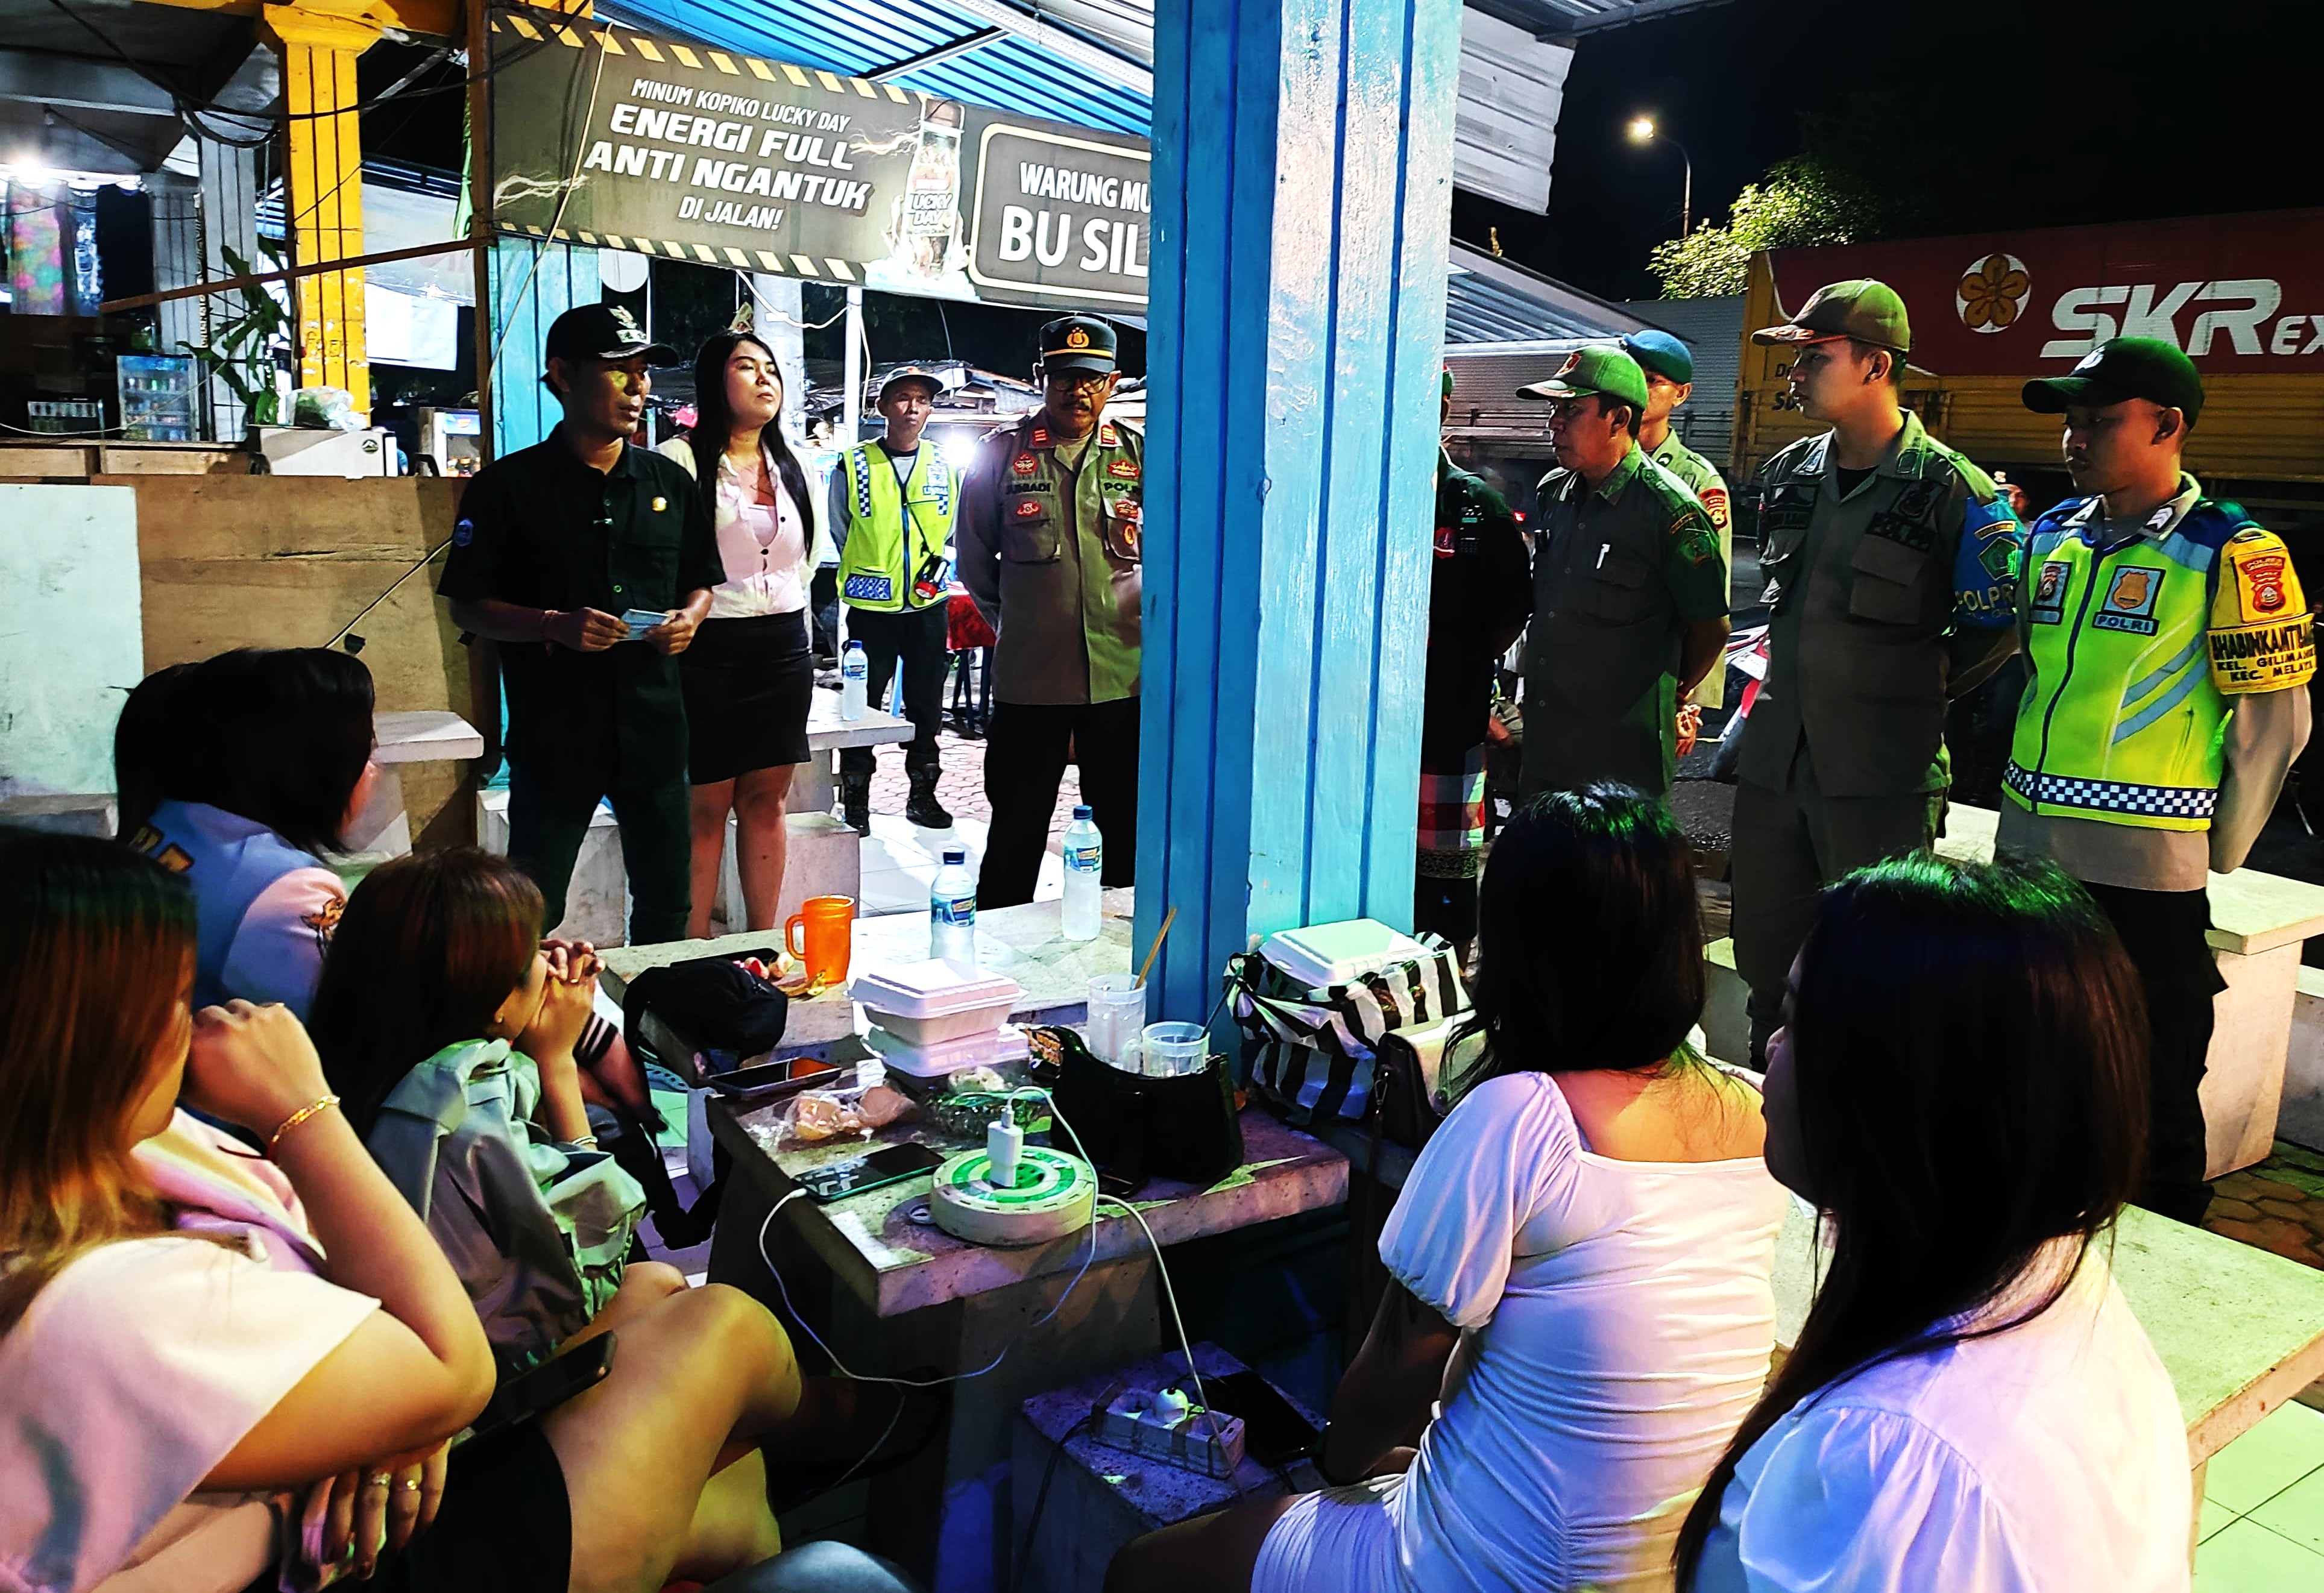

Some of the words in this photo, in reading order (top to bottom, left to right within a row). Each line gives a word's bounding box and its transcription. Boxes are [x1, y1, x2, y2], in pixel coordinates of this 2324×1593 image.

[631, 78, 692, 107] MINUM
[694, 90, 760, 118] KOPIKO
[760, 101, 818, 127] LUCKY
[818, 112, 852, 133] DAY
[610, 102, 754, 154] ENERGI
[757, 128, 854, 171] FULL
[583, 140, 687, 183] ANTI
[690, 157, 874, 210] NGANTUK
[1019, 161, 1119, 208] WARUNG
[678, 196, 702, 219] DI
[704, 201, 784, 230] JALAN!
[906, 193, 953, 214] LUCKY
[913, 210, 945, 226] DAY
[998, 204, 1072, 267] BU
[1079, 218, 1149, 278] SIL
[2098, 615, 2150, 632] POLRI
